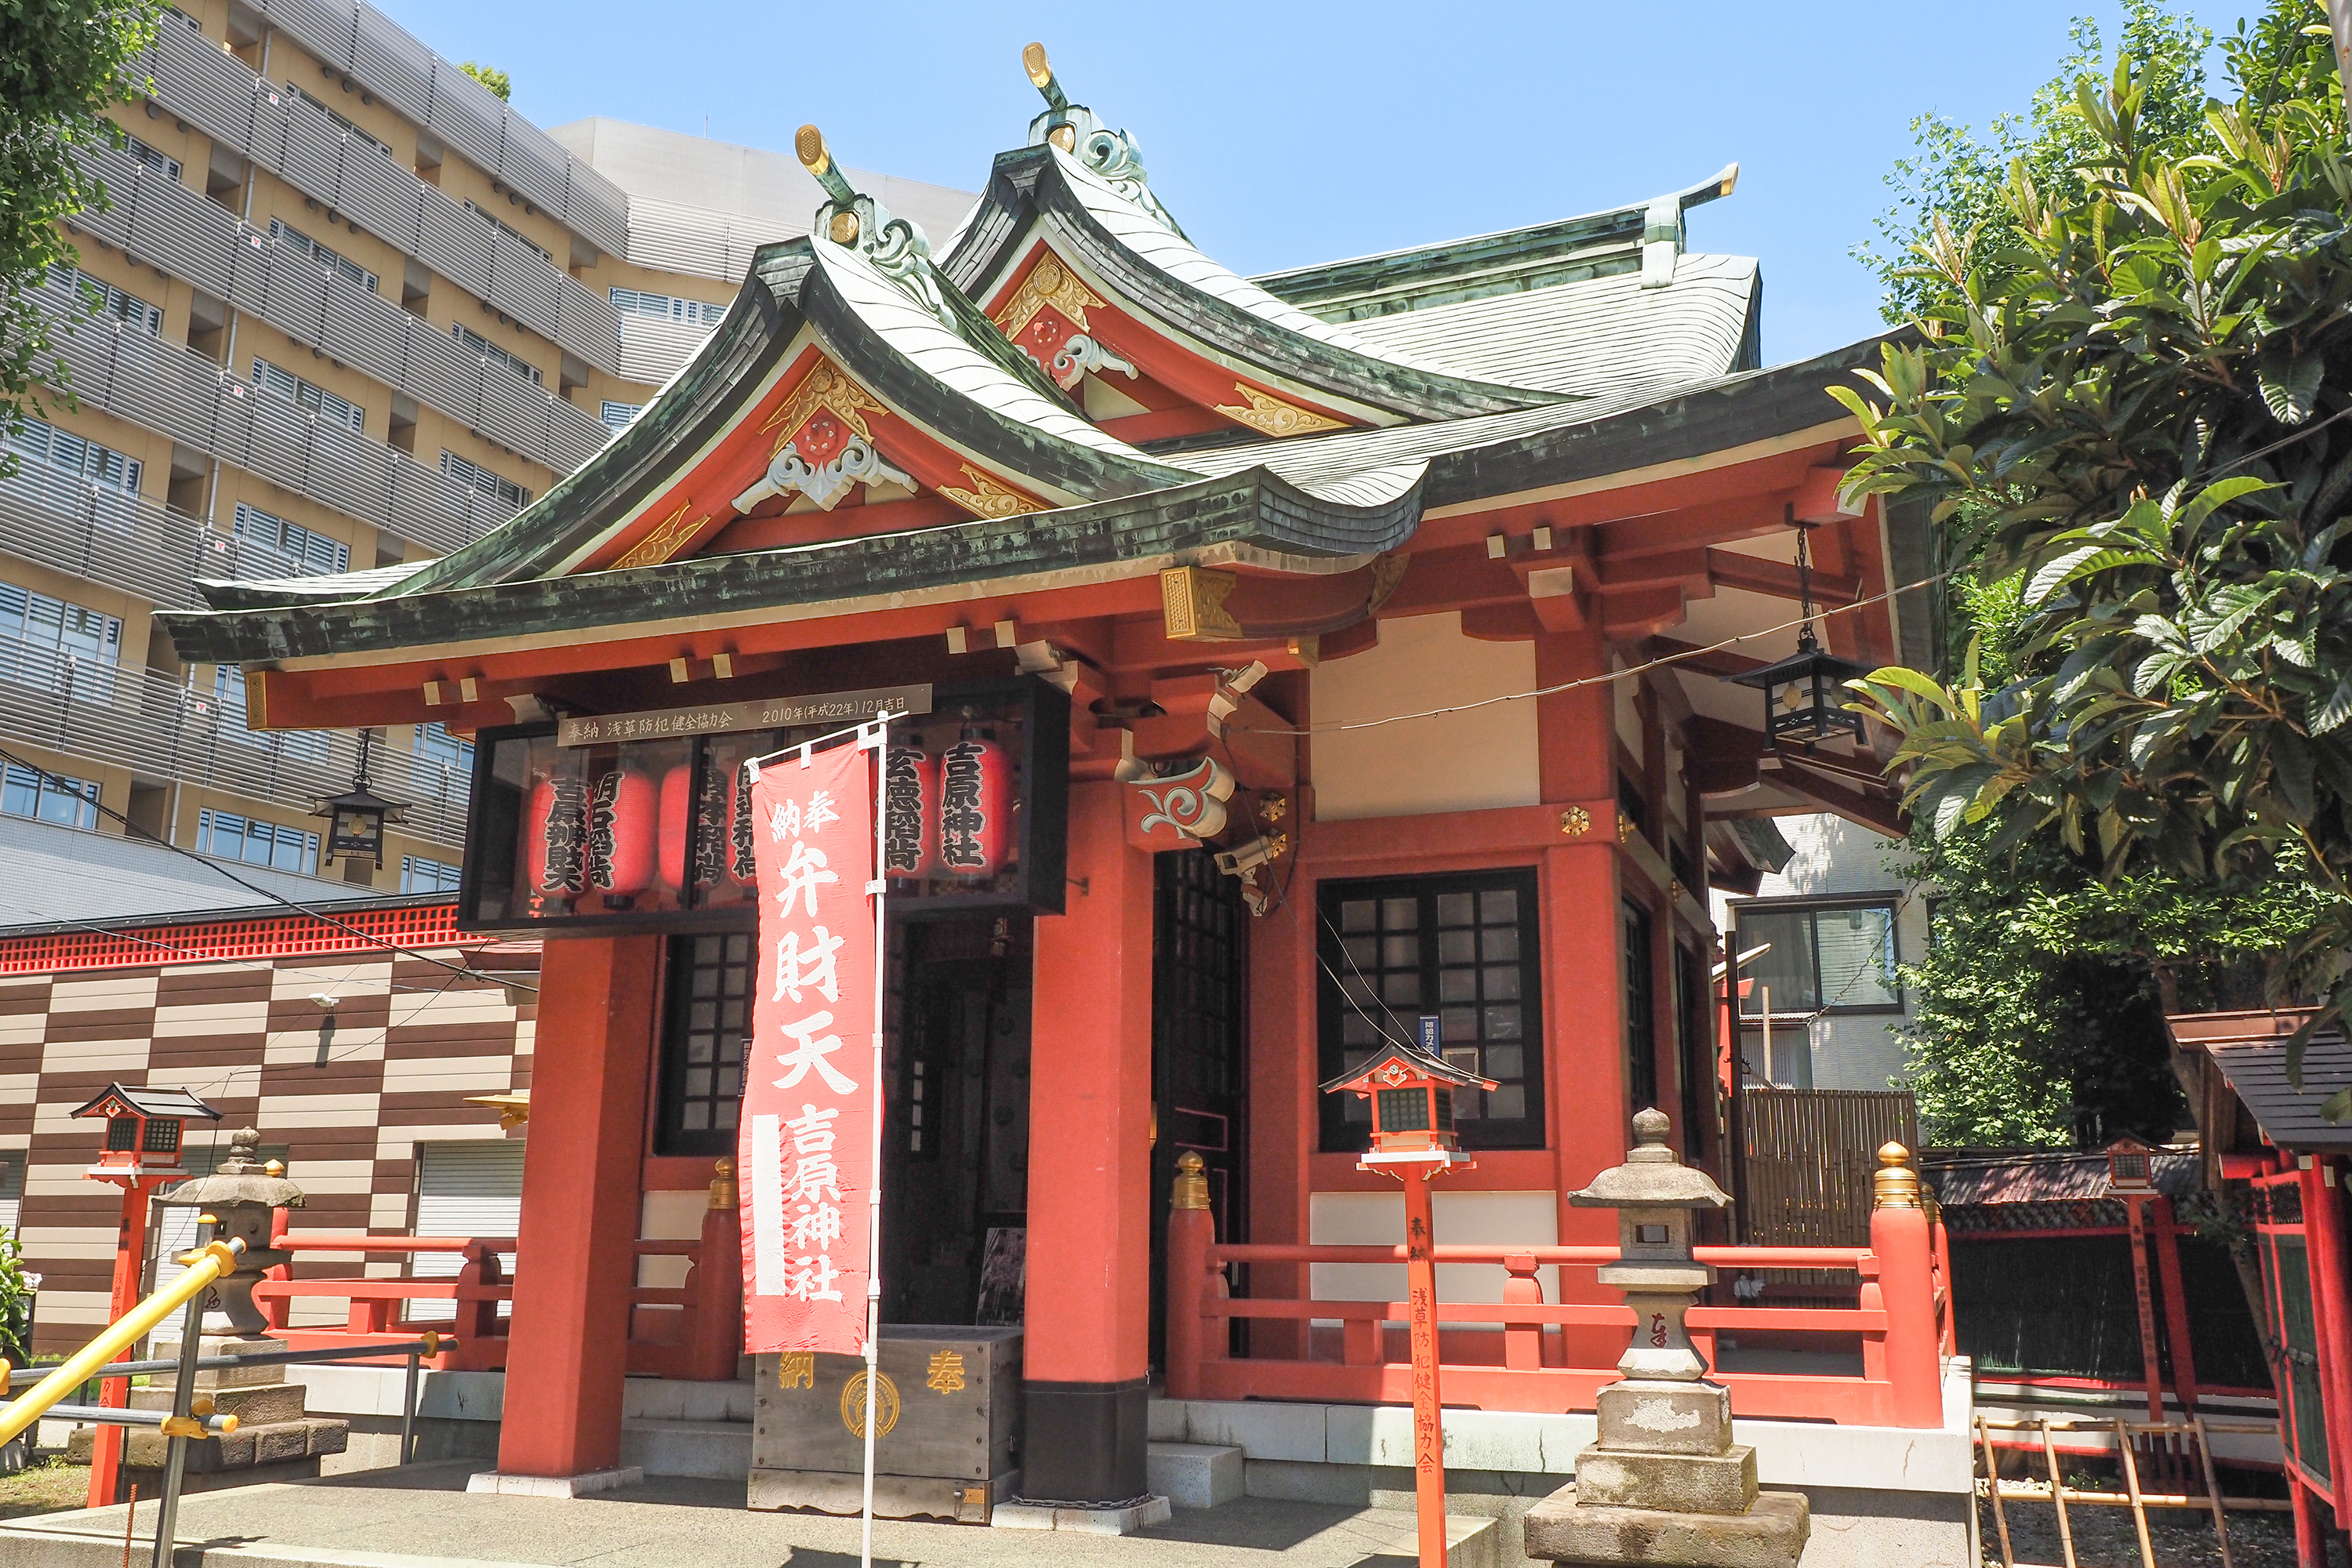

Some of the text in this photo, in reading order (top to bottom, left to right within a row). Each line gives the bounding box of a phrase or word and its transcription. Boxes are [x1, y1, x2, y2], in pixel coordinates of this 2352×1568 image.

[568, 721, 600, 742] 奉納
[607, 710, 734, 738] 浅草防犯健全協力会
[770, 789, 841, 843] 奉納
[942, 742, 986, 867] 吉原神社
[771, 840, 859, 1095] 弁財天
[783, 1103, 842, 1303] 吉原神社
[779, 1350, 966, 1396] 奉 納
[1413, 1287, 1436, 1475] 浅草防犯健全協力会
